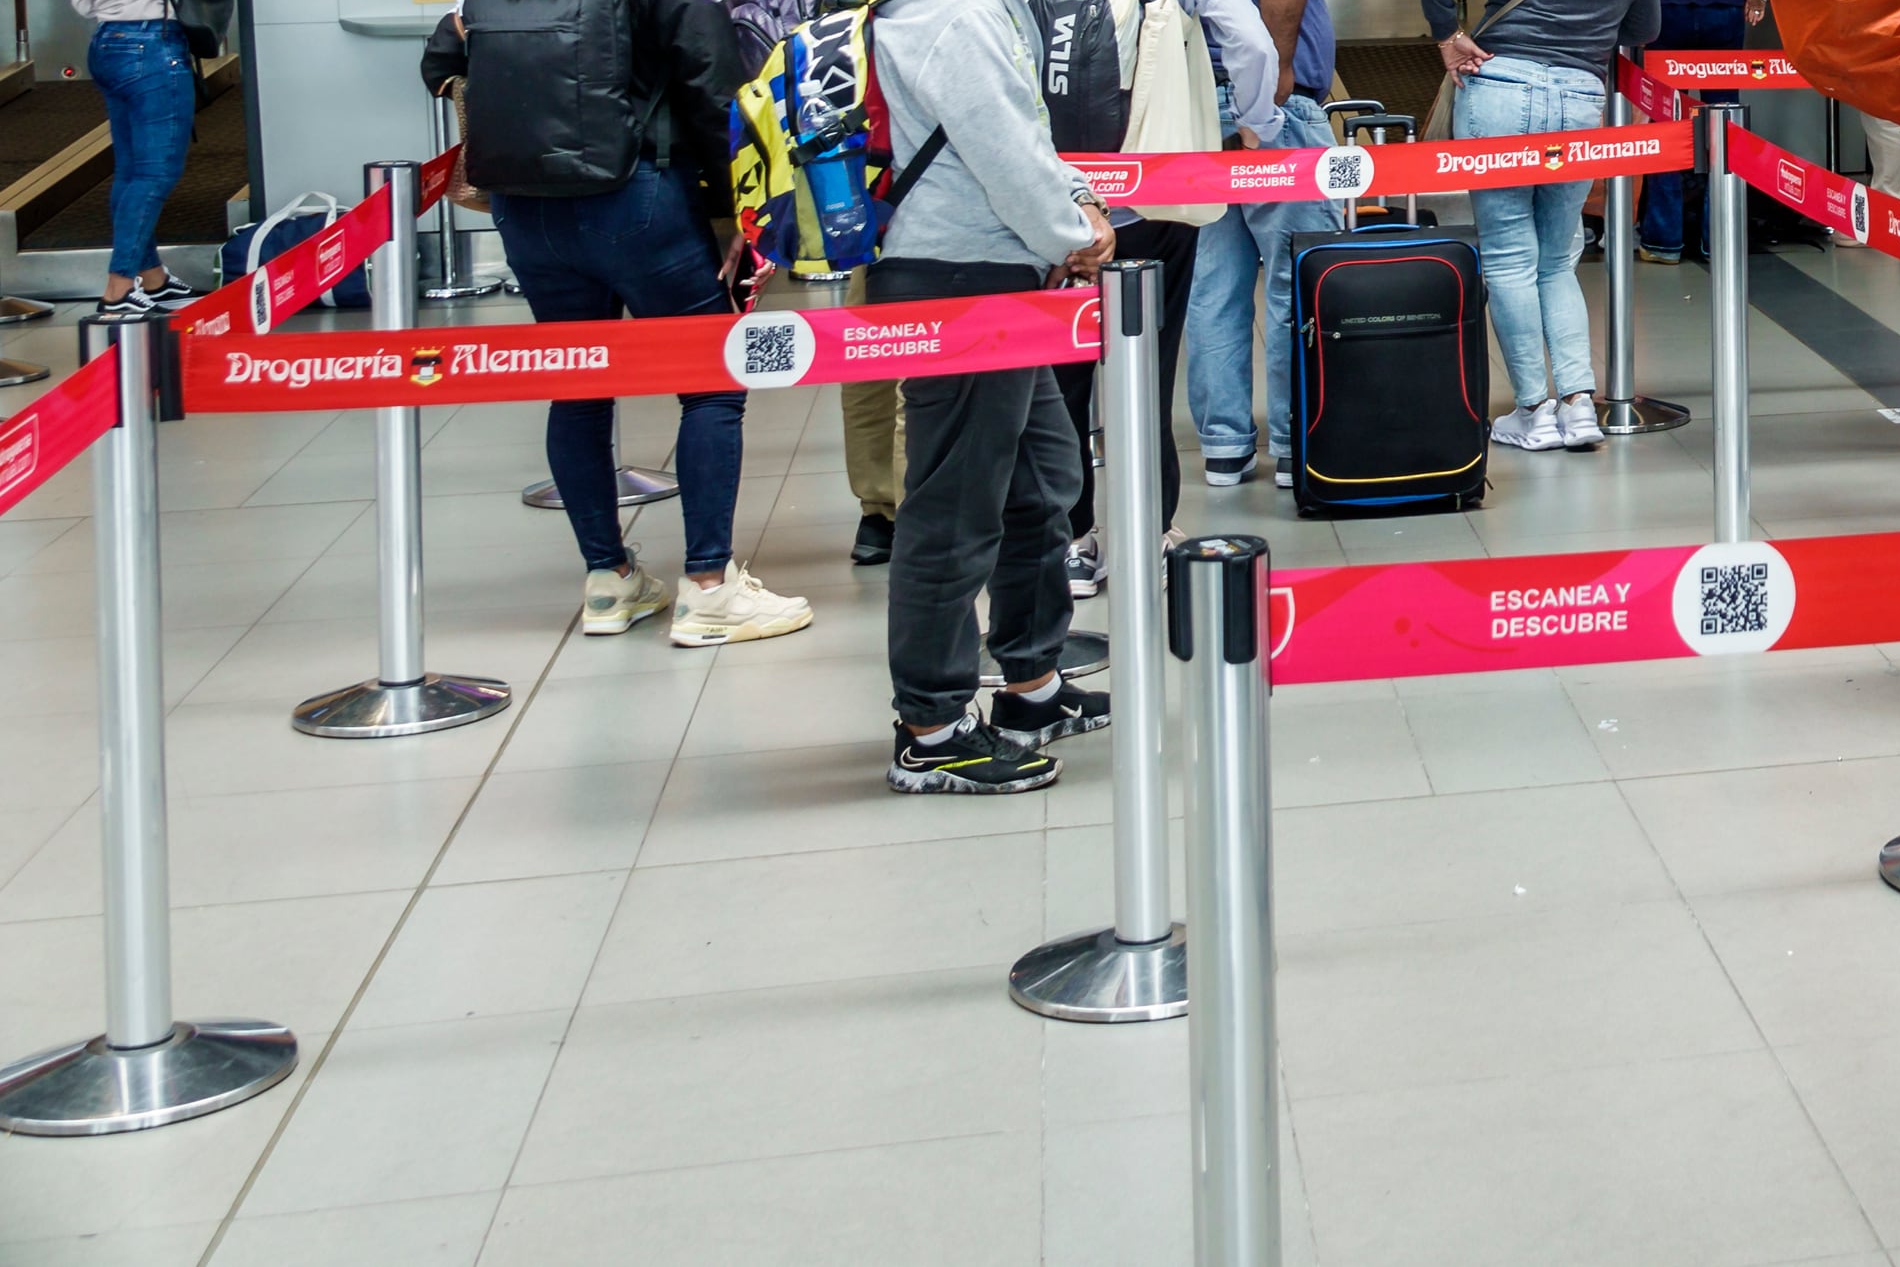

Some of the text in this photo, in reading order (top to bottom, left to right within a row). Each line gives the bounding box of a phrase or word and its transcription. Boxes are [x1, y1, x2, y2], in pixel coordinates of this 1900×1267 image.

[1047, 13, 1077, 96] SILVA
[1665, 59, 1749, 79] Droguería
[1436, 135, 1661, 175] Droguería Alemana
[1230, 162, 1298, 177] ESCANEA Y
[1230, 175, 1296, 189] DESCUBRE
[843, 320, 943, 341] ESCANEA Y
[843, 339, 941, 361] DESCUBRE
[225, 343, 610, 388] Droguería Alemana
[1490, 582, 1632, 614] ESCANEA Y
[1490, 610, 1629, 640] DESCUBRE
